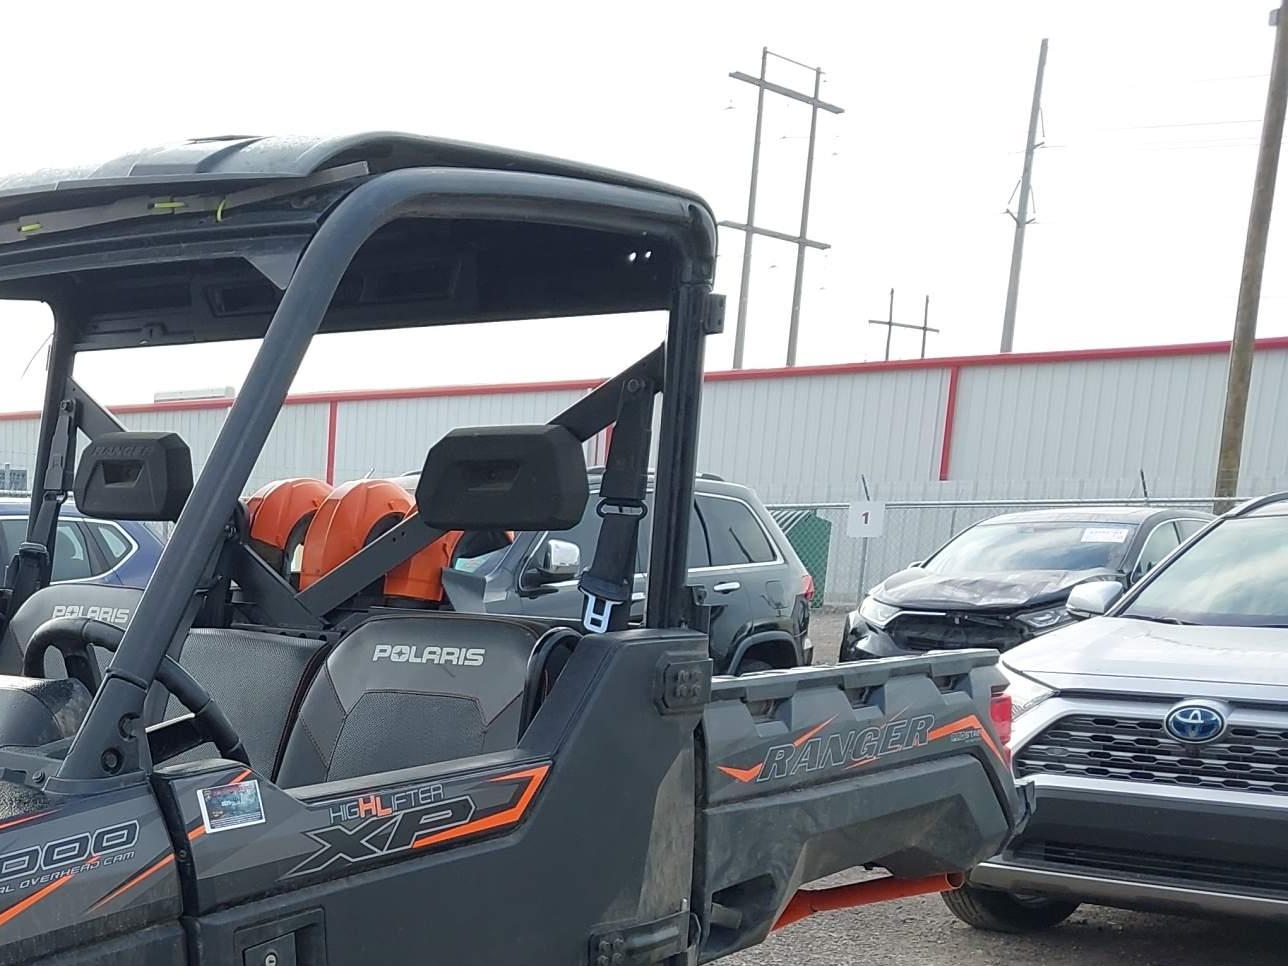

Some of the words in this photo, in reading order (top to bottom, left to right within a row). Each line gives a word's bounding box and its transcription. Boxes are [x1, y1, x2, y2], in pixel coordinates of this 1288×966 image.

[862, 511, 869, 525] 1
[52, 605, 130, 623] POLARIS
[372, 644, 486, 666] POLARIS
[757, 713, 936, 783] RANGER
[329, 784, 445, 825] HIGHLIFTER
[275, 795, 476, 880] XP
[19, 860, 101, 889] OVERHEAD
[103, 851, 136, 866] CAM
